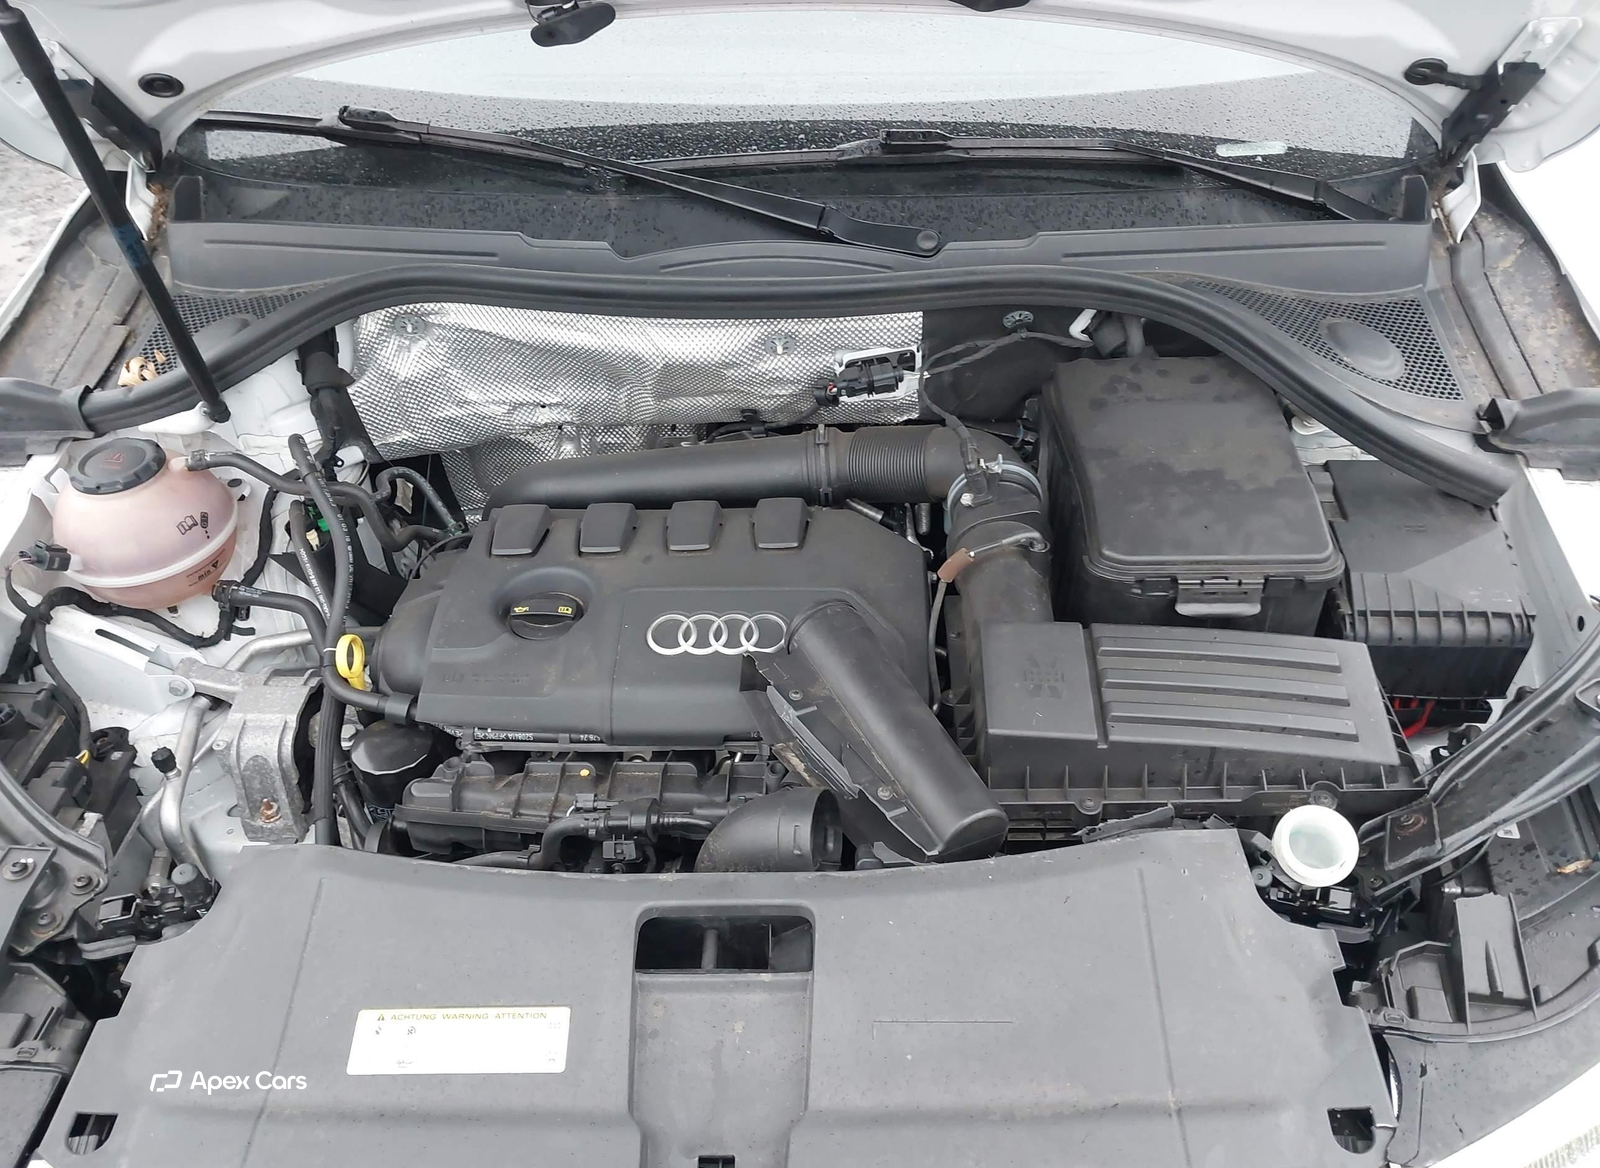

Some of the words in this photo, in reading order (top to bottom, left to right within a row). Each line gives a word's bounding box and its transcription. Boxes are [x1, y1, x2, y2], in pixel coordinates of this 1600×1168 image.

[198, 569, 211, 581] min
[390, 1013, 437, 1021] ACHTUNG
[494, 1012, 548, 1020] ATTENTION
